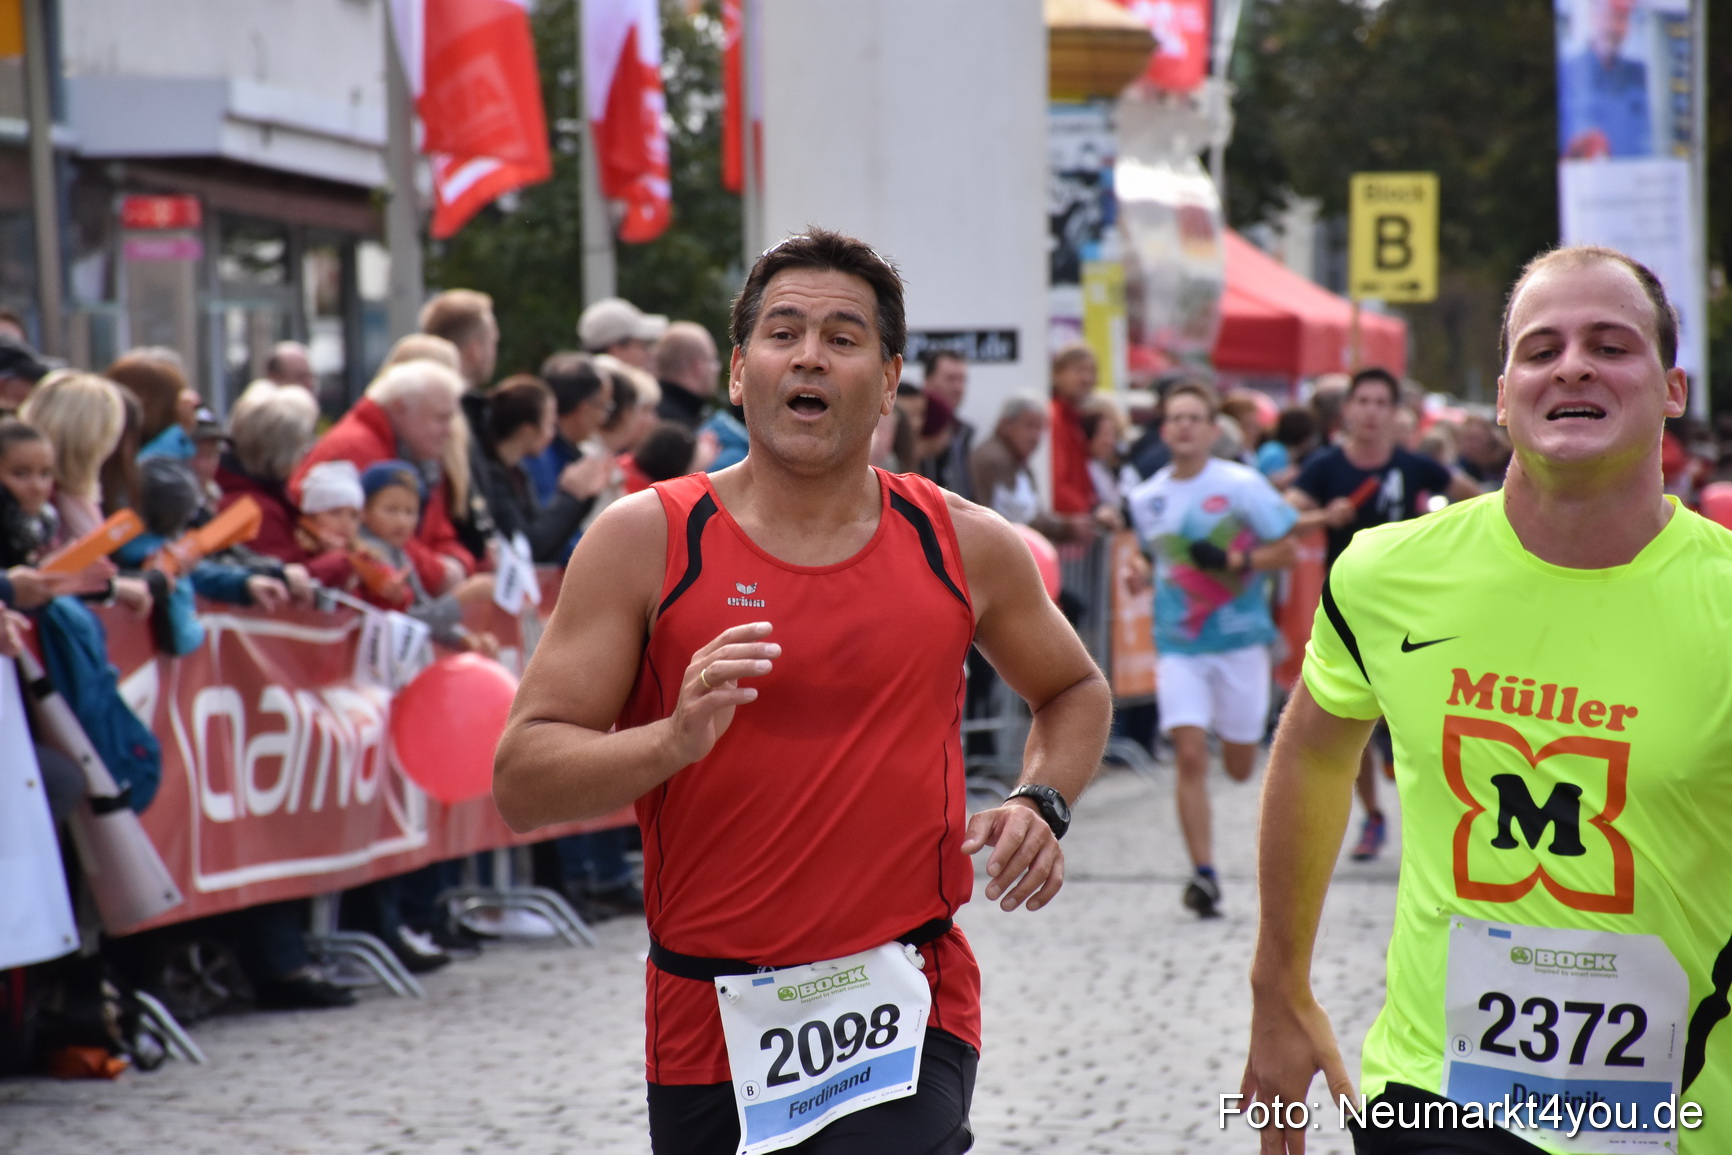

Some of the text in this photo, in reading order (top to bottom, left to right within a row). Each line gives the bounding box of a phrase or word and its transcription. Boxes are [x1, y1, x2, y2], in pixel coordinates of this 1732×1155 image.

[1375, 215, 1412, 270] B
[1446, 667, 1639, 732] Müller
[1490, 773, 1587, 857] M
[798, 965, 869, 998] BOCK
[1535, 948, 1618, 972] BOCK
[1535, 967, 1559, 975] inspired
[800, 994, 823, 1004] inspired
[847, 982, 871, 991] concepts
[760, 1003, 900, 1088] 2098
[1458, 1040, 1466, 1052] B
[1479, 991, 1648, 1067] 2372
[746, 1085, 755, 1097] B
[789, 1066, 872, 1120] Ferdinand
